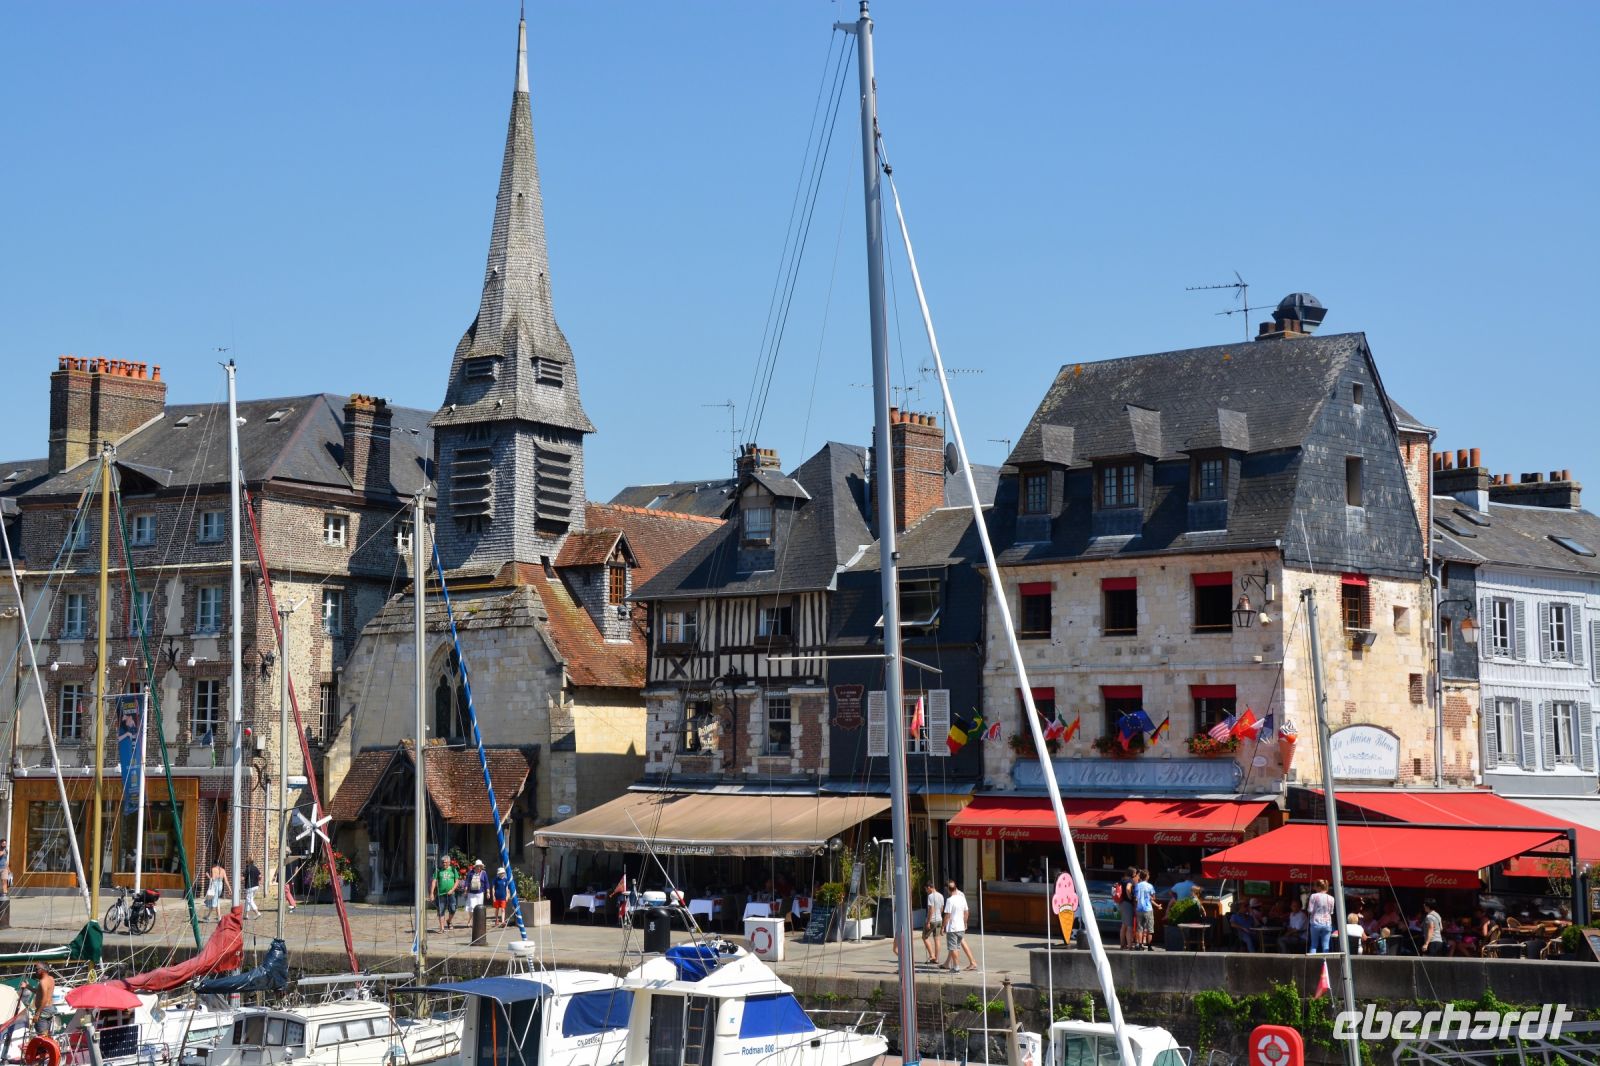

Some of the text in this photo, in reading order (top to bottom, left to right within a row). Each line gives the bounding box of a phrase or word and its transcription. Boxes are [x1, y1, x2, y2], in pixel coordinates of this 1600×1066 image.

[1158, 766, 1225, 787] Bleue
[1153, 831, 1183, 844] Glaces
[1189, 832, 1198, 843] &
[675, 845, 716, 855] HONFLEUR
[1219, 865, 1458, 887] Crêpes Bar Brasserie Glaces
[742, 1046, 764, 1056] Rodman
